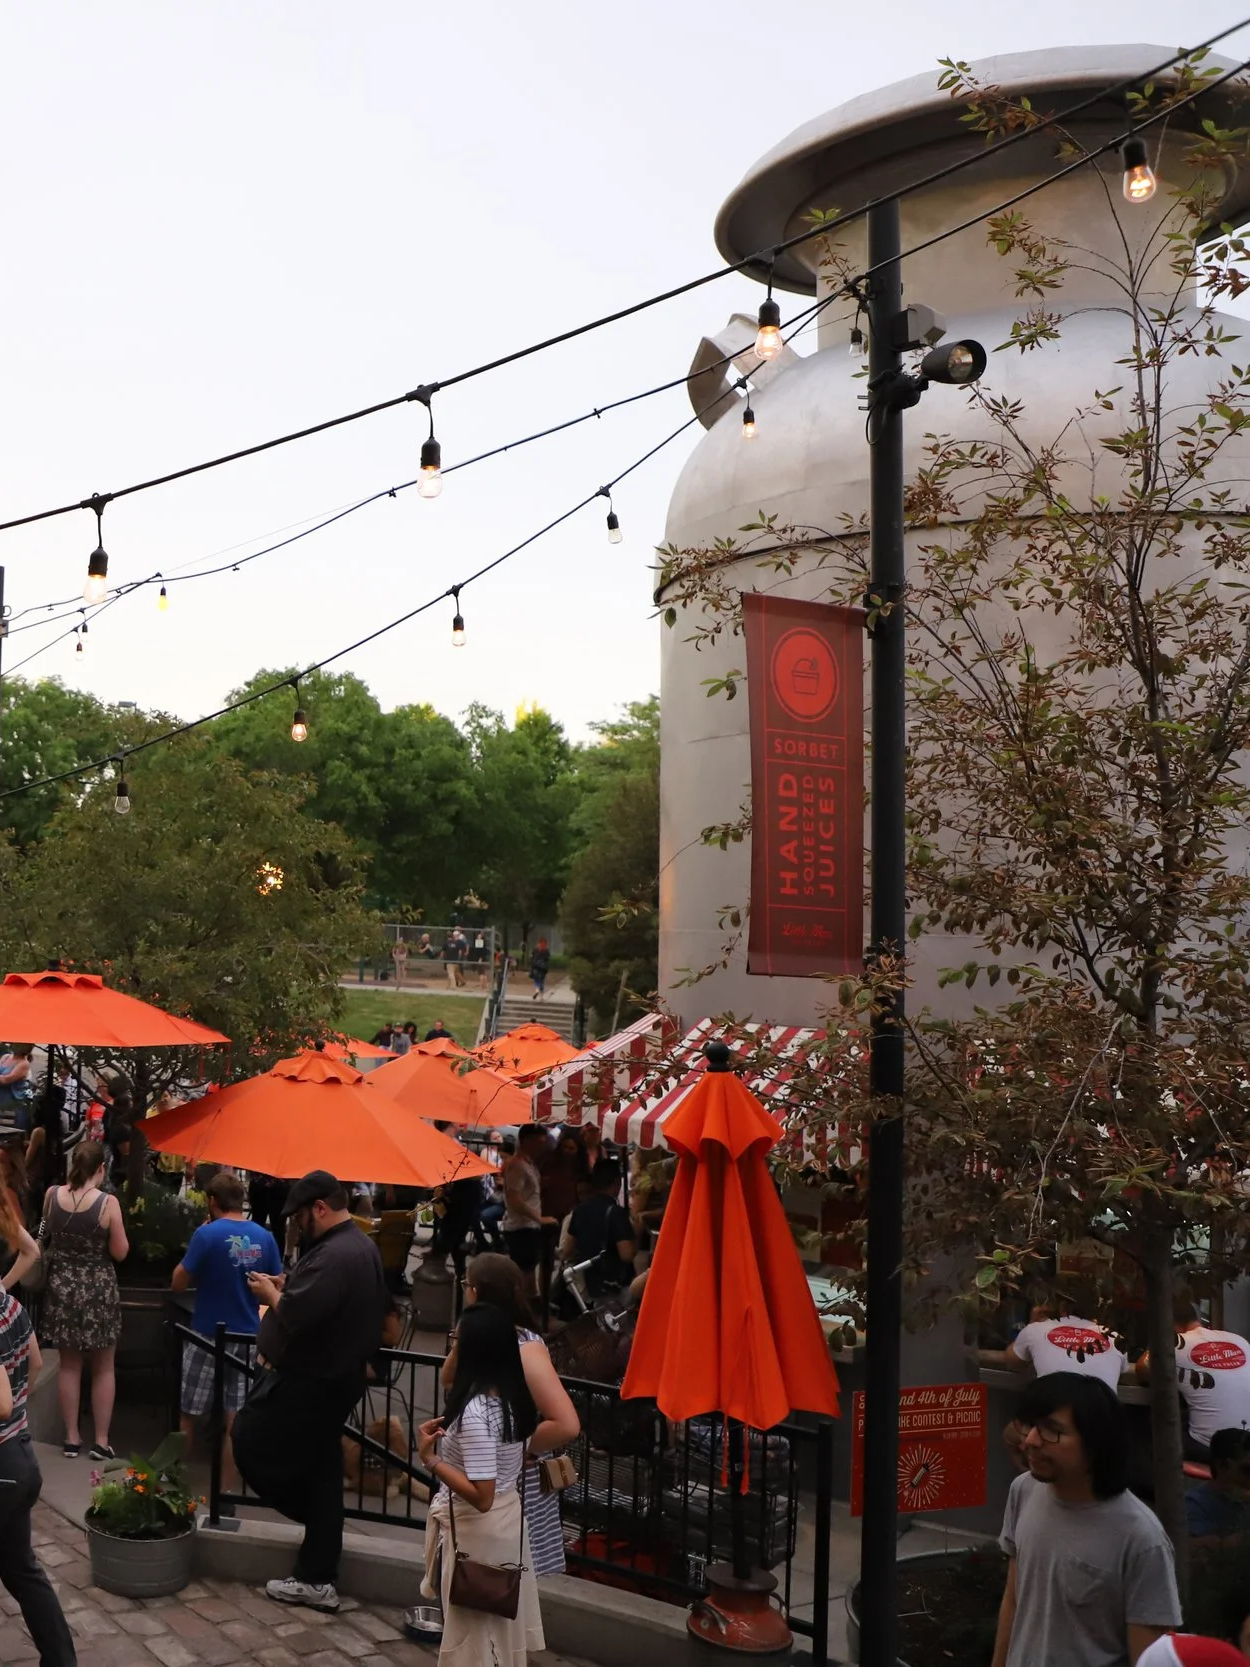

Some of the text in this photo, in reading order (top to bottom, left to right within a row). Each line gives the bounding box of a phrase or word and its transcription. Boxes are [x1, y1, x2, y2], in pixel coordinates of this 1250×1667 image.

[774, 738, 839, 761] SORBET
[778, 772, 799, 896] HAND
[802, 774, 816, 896] SQUEEZED
[818, 776, 836, 898] JUICES
[1053, 1335, 1081, 1344] Little
[1199, 1349, 1242, 1364] Little Man
[898, 1386, 981, 1407] nd 4th of July
[912, 1412, 945, 1427] CONTEST
[947, 1411, 954, 1424] &
[955, 1410, 982, 1424] PICNIC
